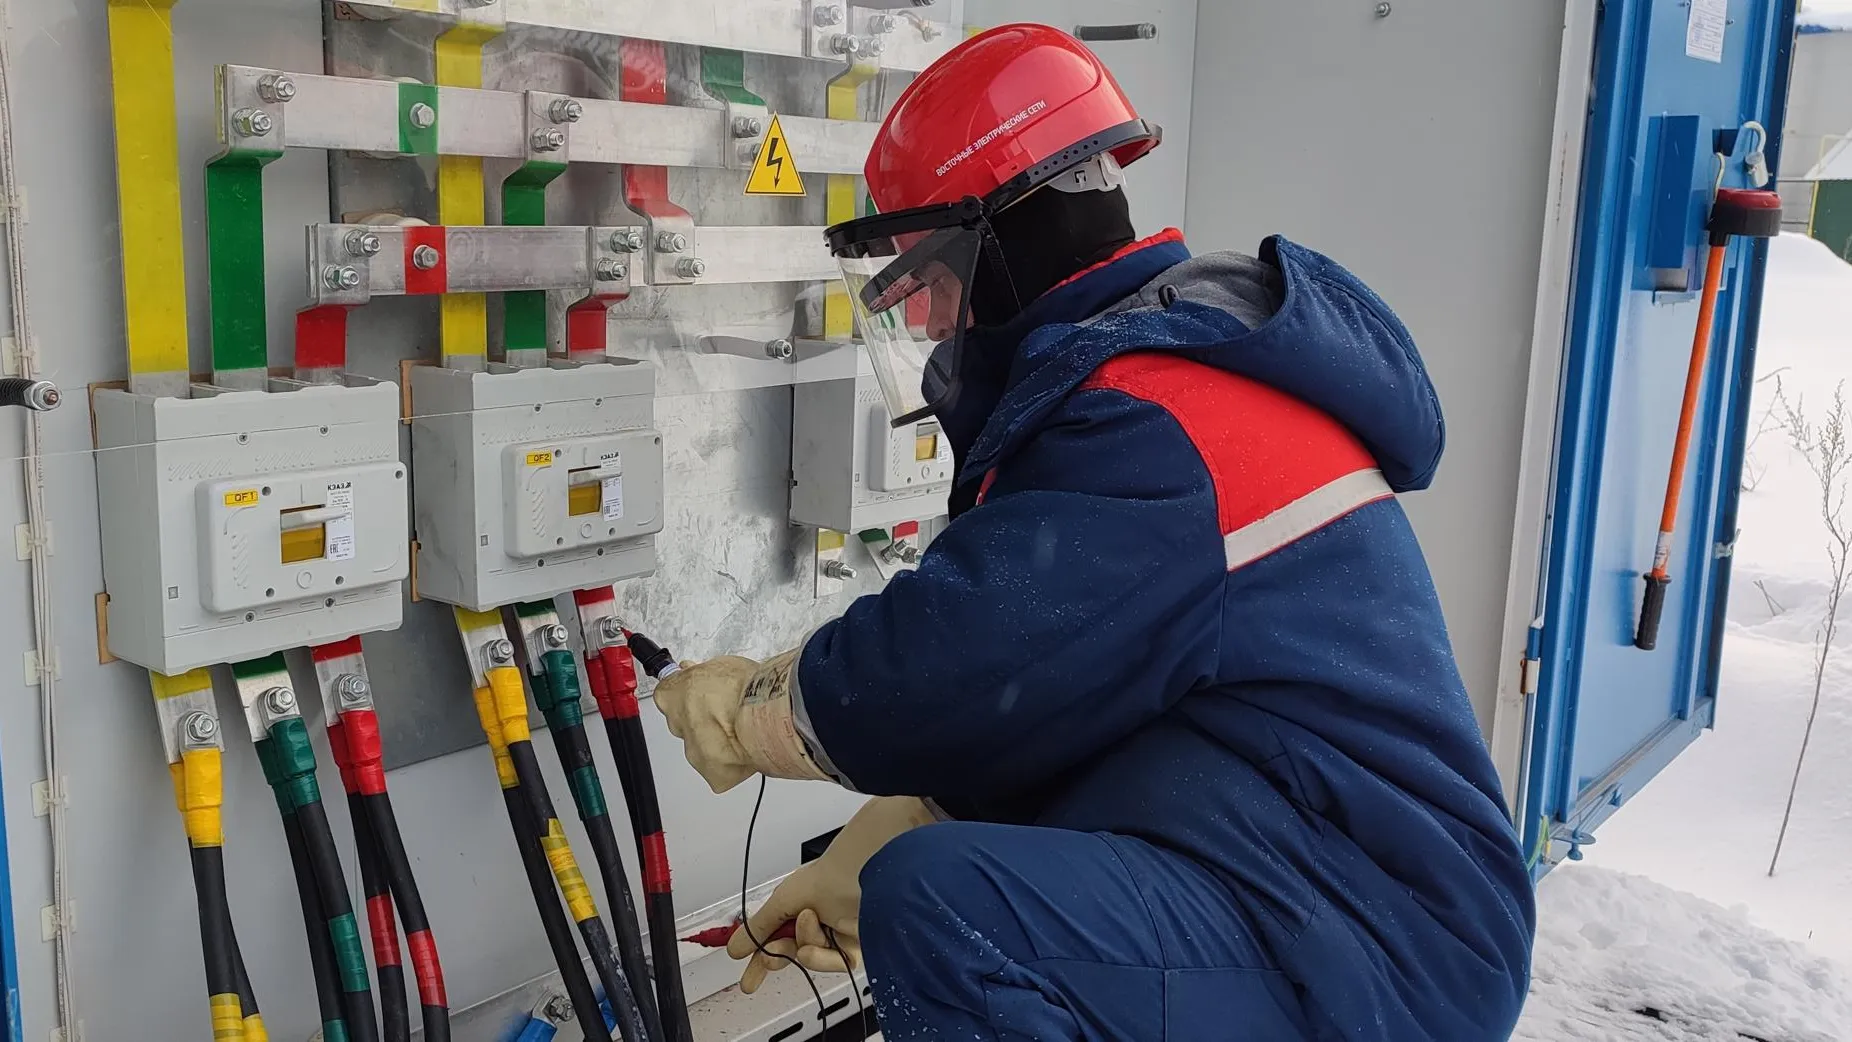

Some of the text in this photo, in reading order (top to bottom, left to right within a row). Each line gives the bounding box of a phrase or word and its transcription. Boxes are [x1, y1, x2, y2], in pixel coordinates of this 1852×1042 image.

[935, 99, 1047, 177] ВОСТОЧНЫЕ ЭЛЕКТРИЧЕСКИЕ СЕТИ
[533, 454, 550, 462] QF2
[234, 492, 254, 502] QF1
